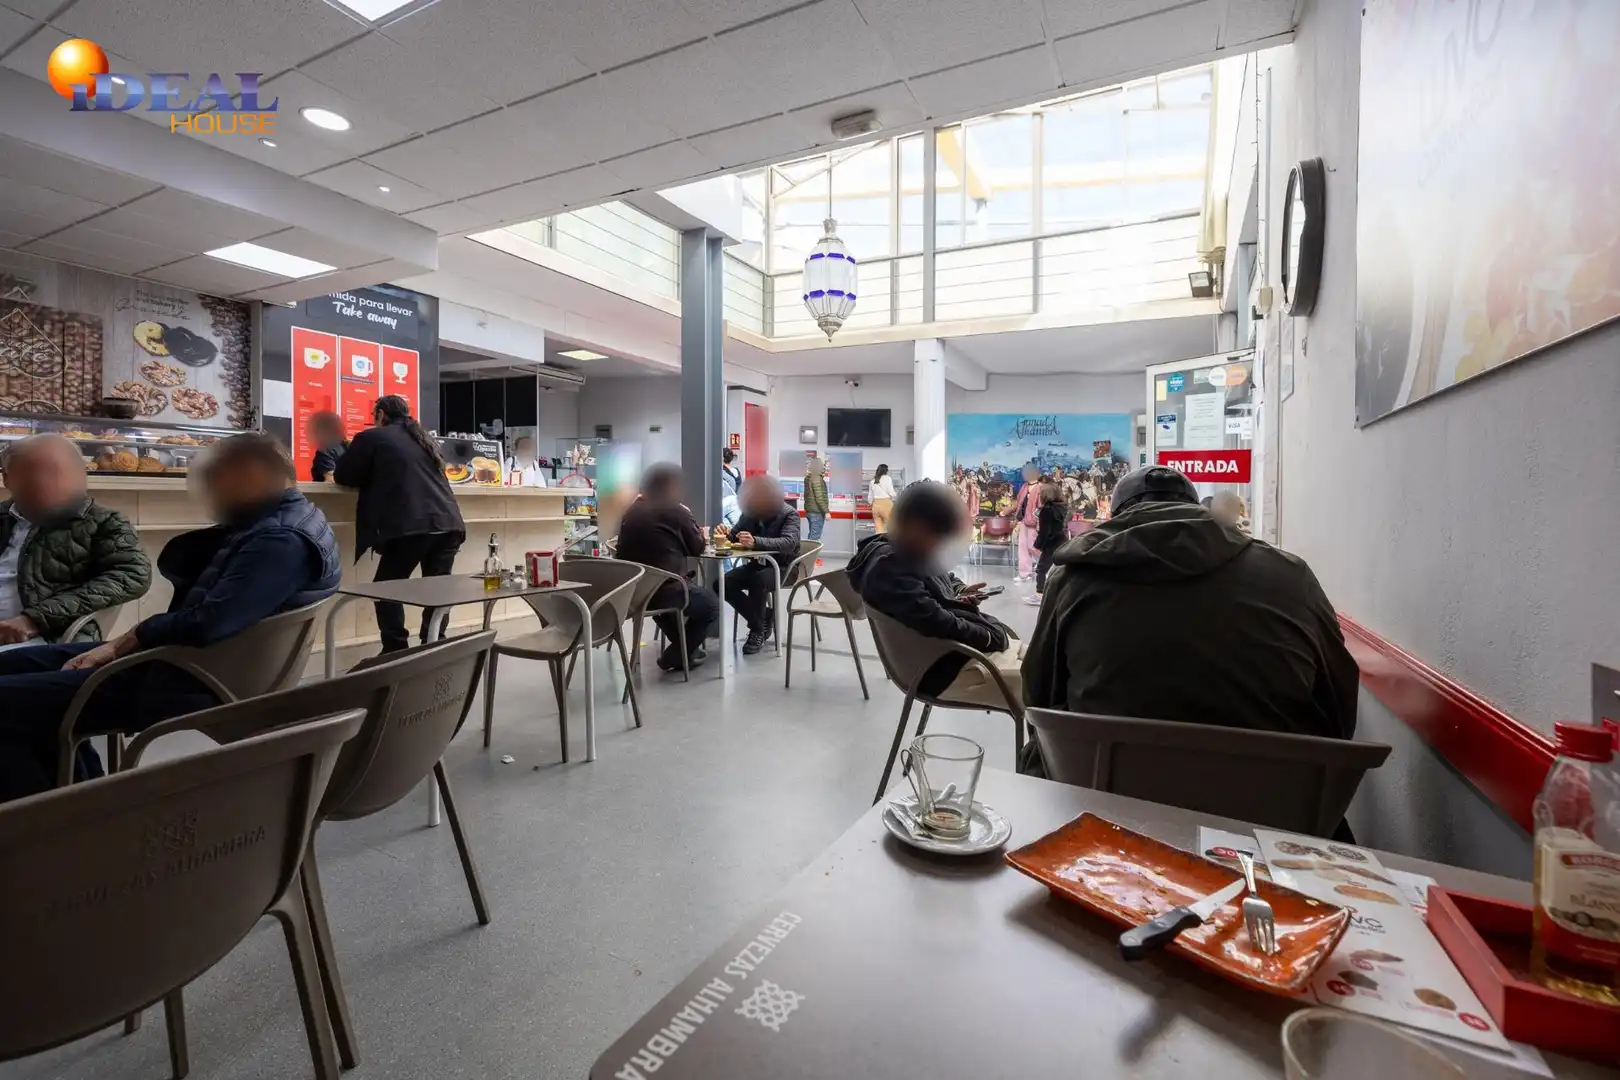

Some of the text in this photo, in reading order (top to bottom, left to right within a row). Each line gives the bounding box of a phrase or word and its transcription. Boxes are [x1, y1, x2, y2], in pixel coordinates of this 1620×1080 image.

[328, 291, 413, 317] mida para llevar
[332, 301, 398, 330] Take away
[614, 911, 803, 1080] CERVEZAS ALHAMBRA
